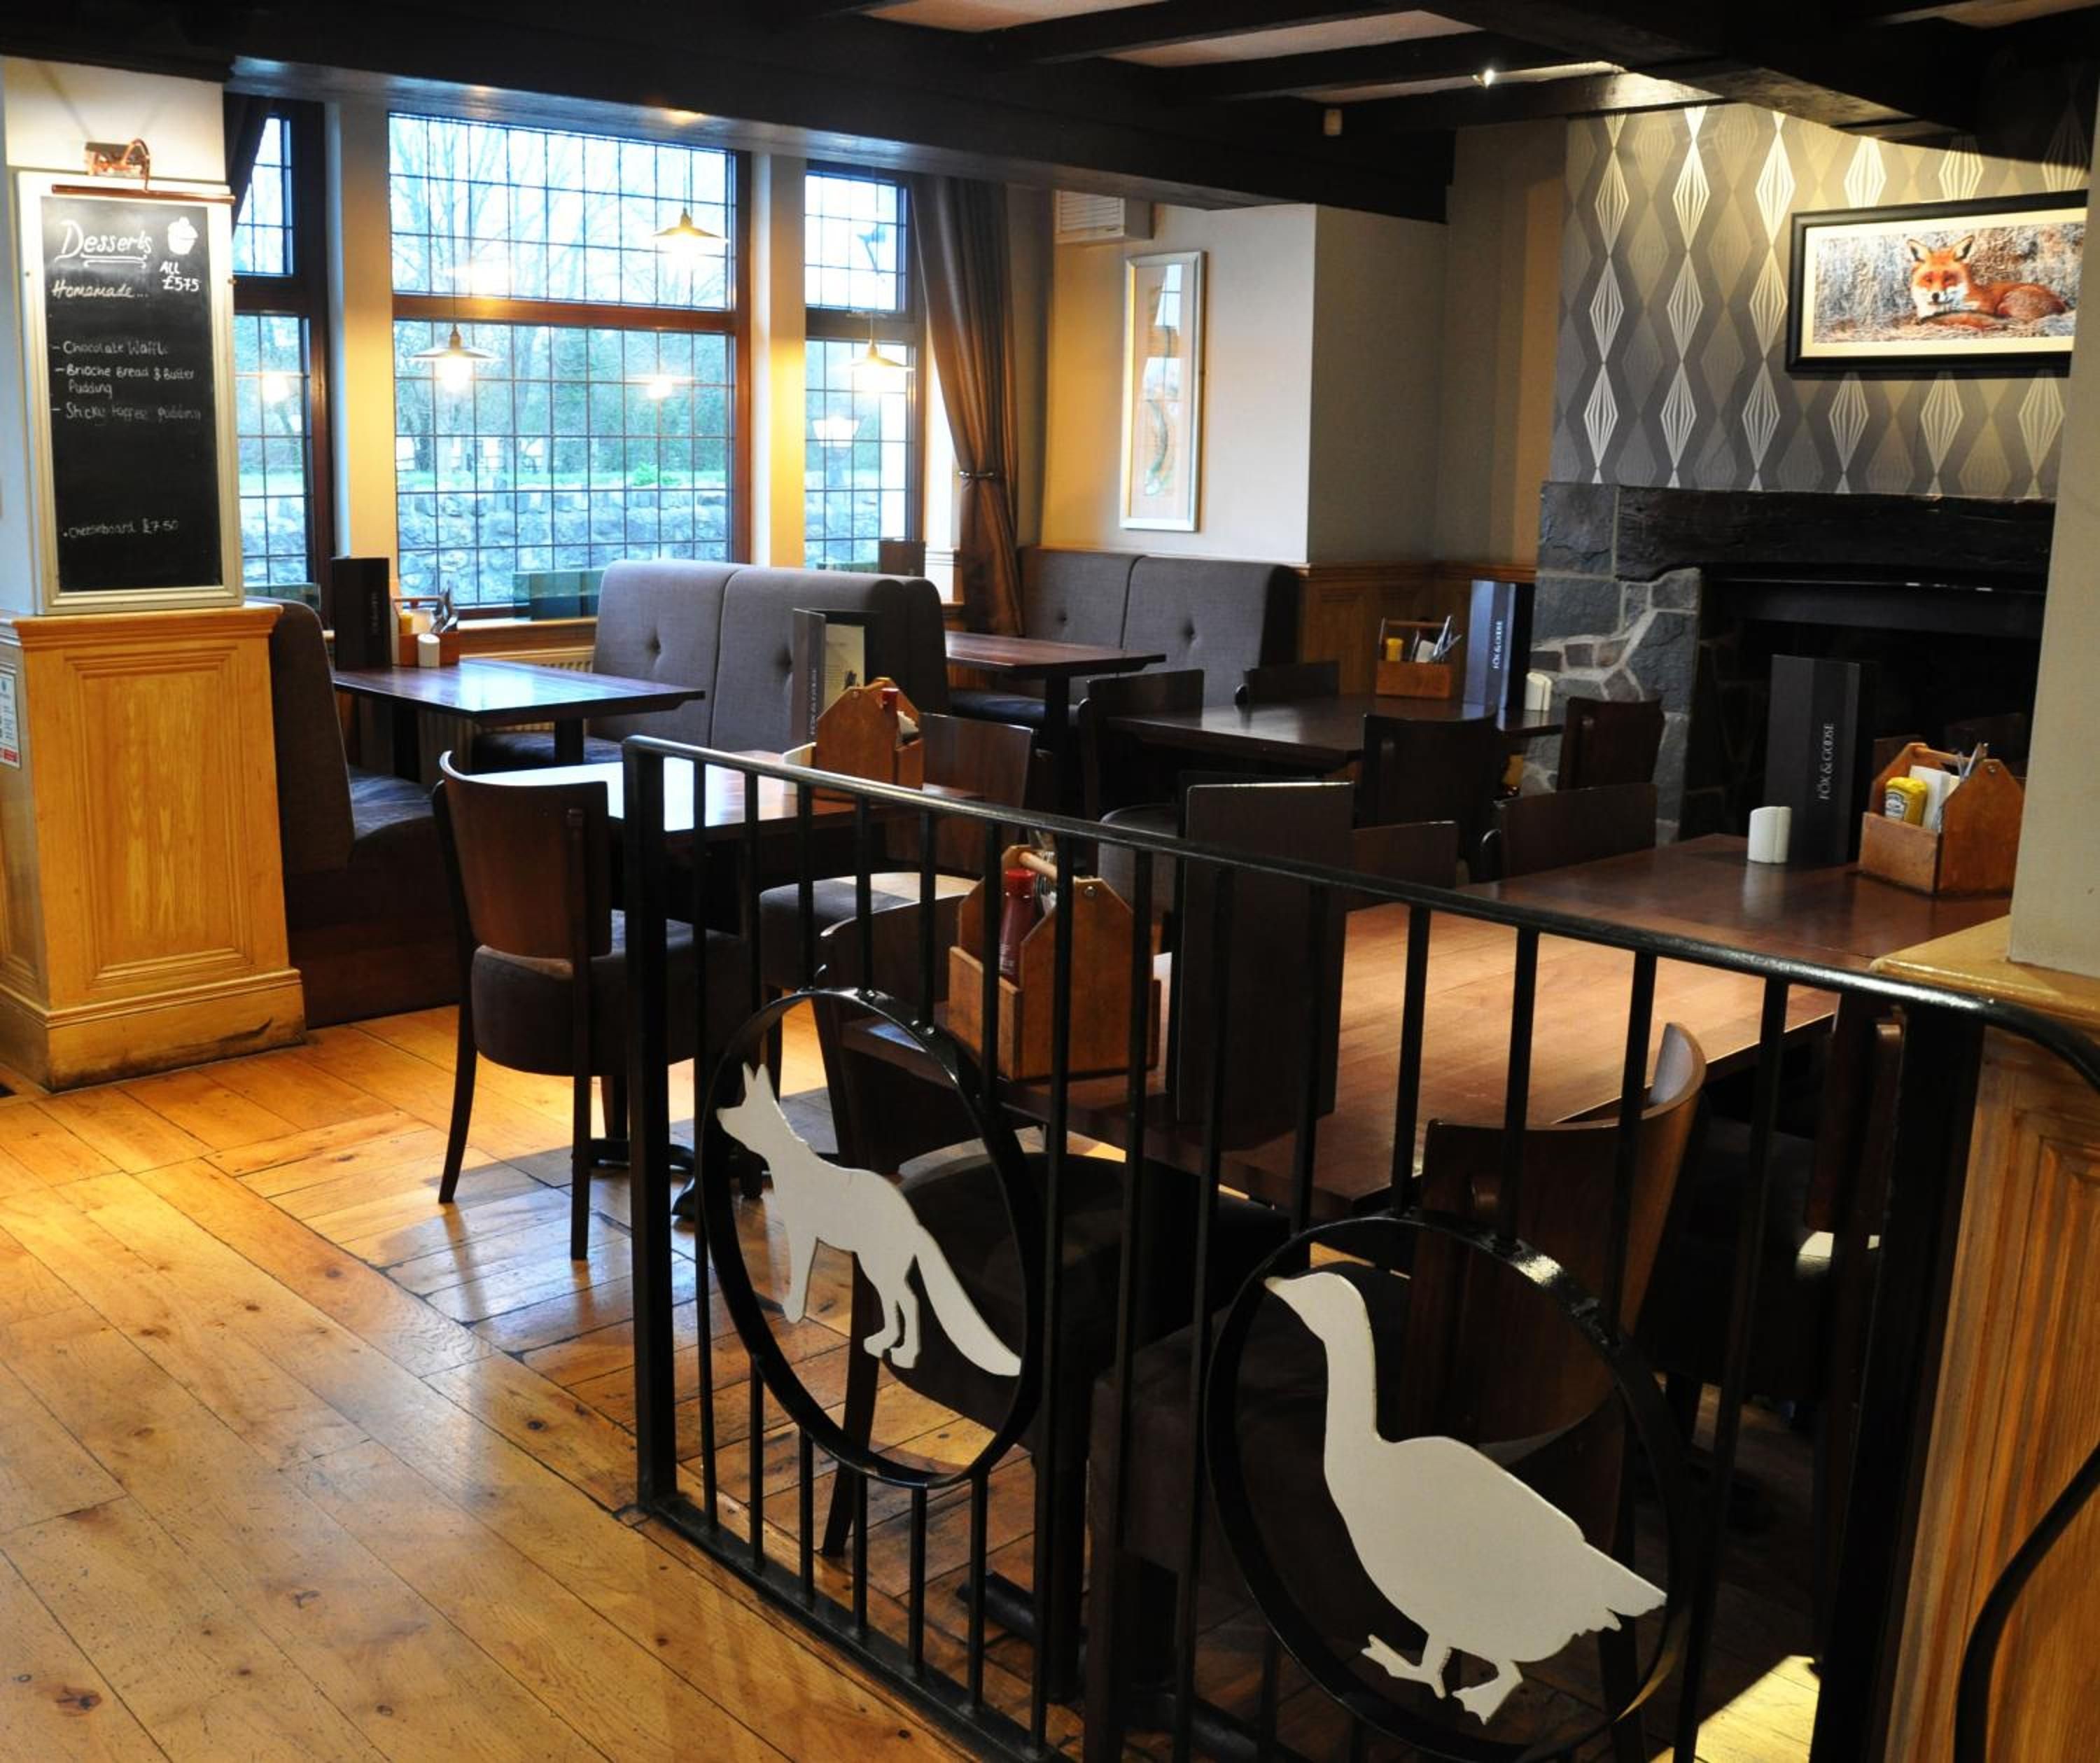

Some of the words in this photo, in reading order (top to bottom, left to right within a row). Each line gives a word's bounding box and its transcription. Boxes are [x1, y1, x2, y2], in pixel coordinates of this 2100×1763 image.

[55, 219, 152, 262] Desserts
[159, 260, 181, 274] ALL
[63, 340, 124, 355] Chocolate
[66, 363, 111, 377] Brioche
[116, 368, 149, 377] Bread
[69, 379, 113, 399] Pudding
